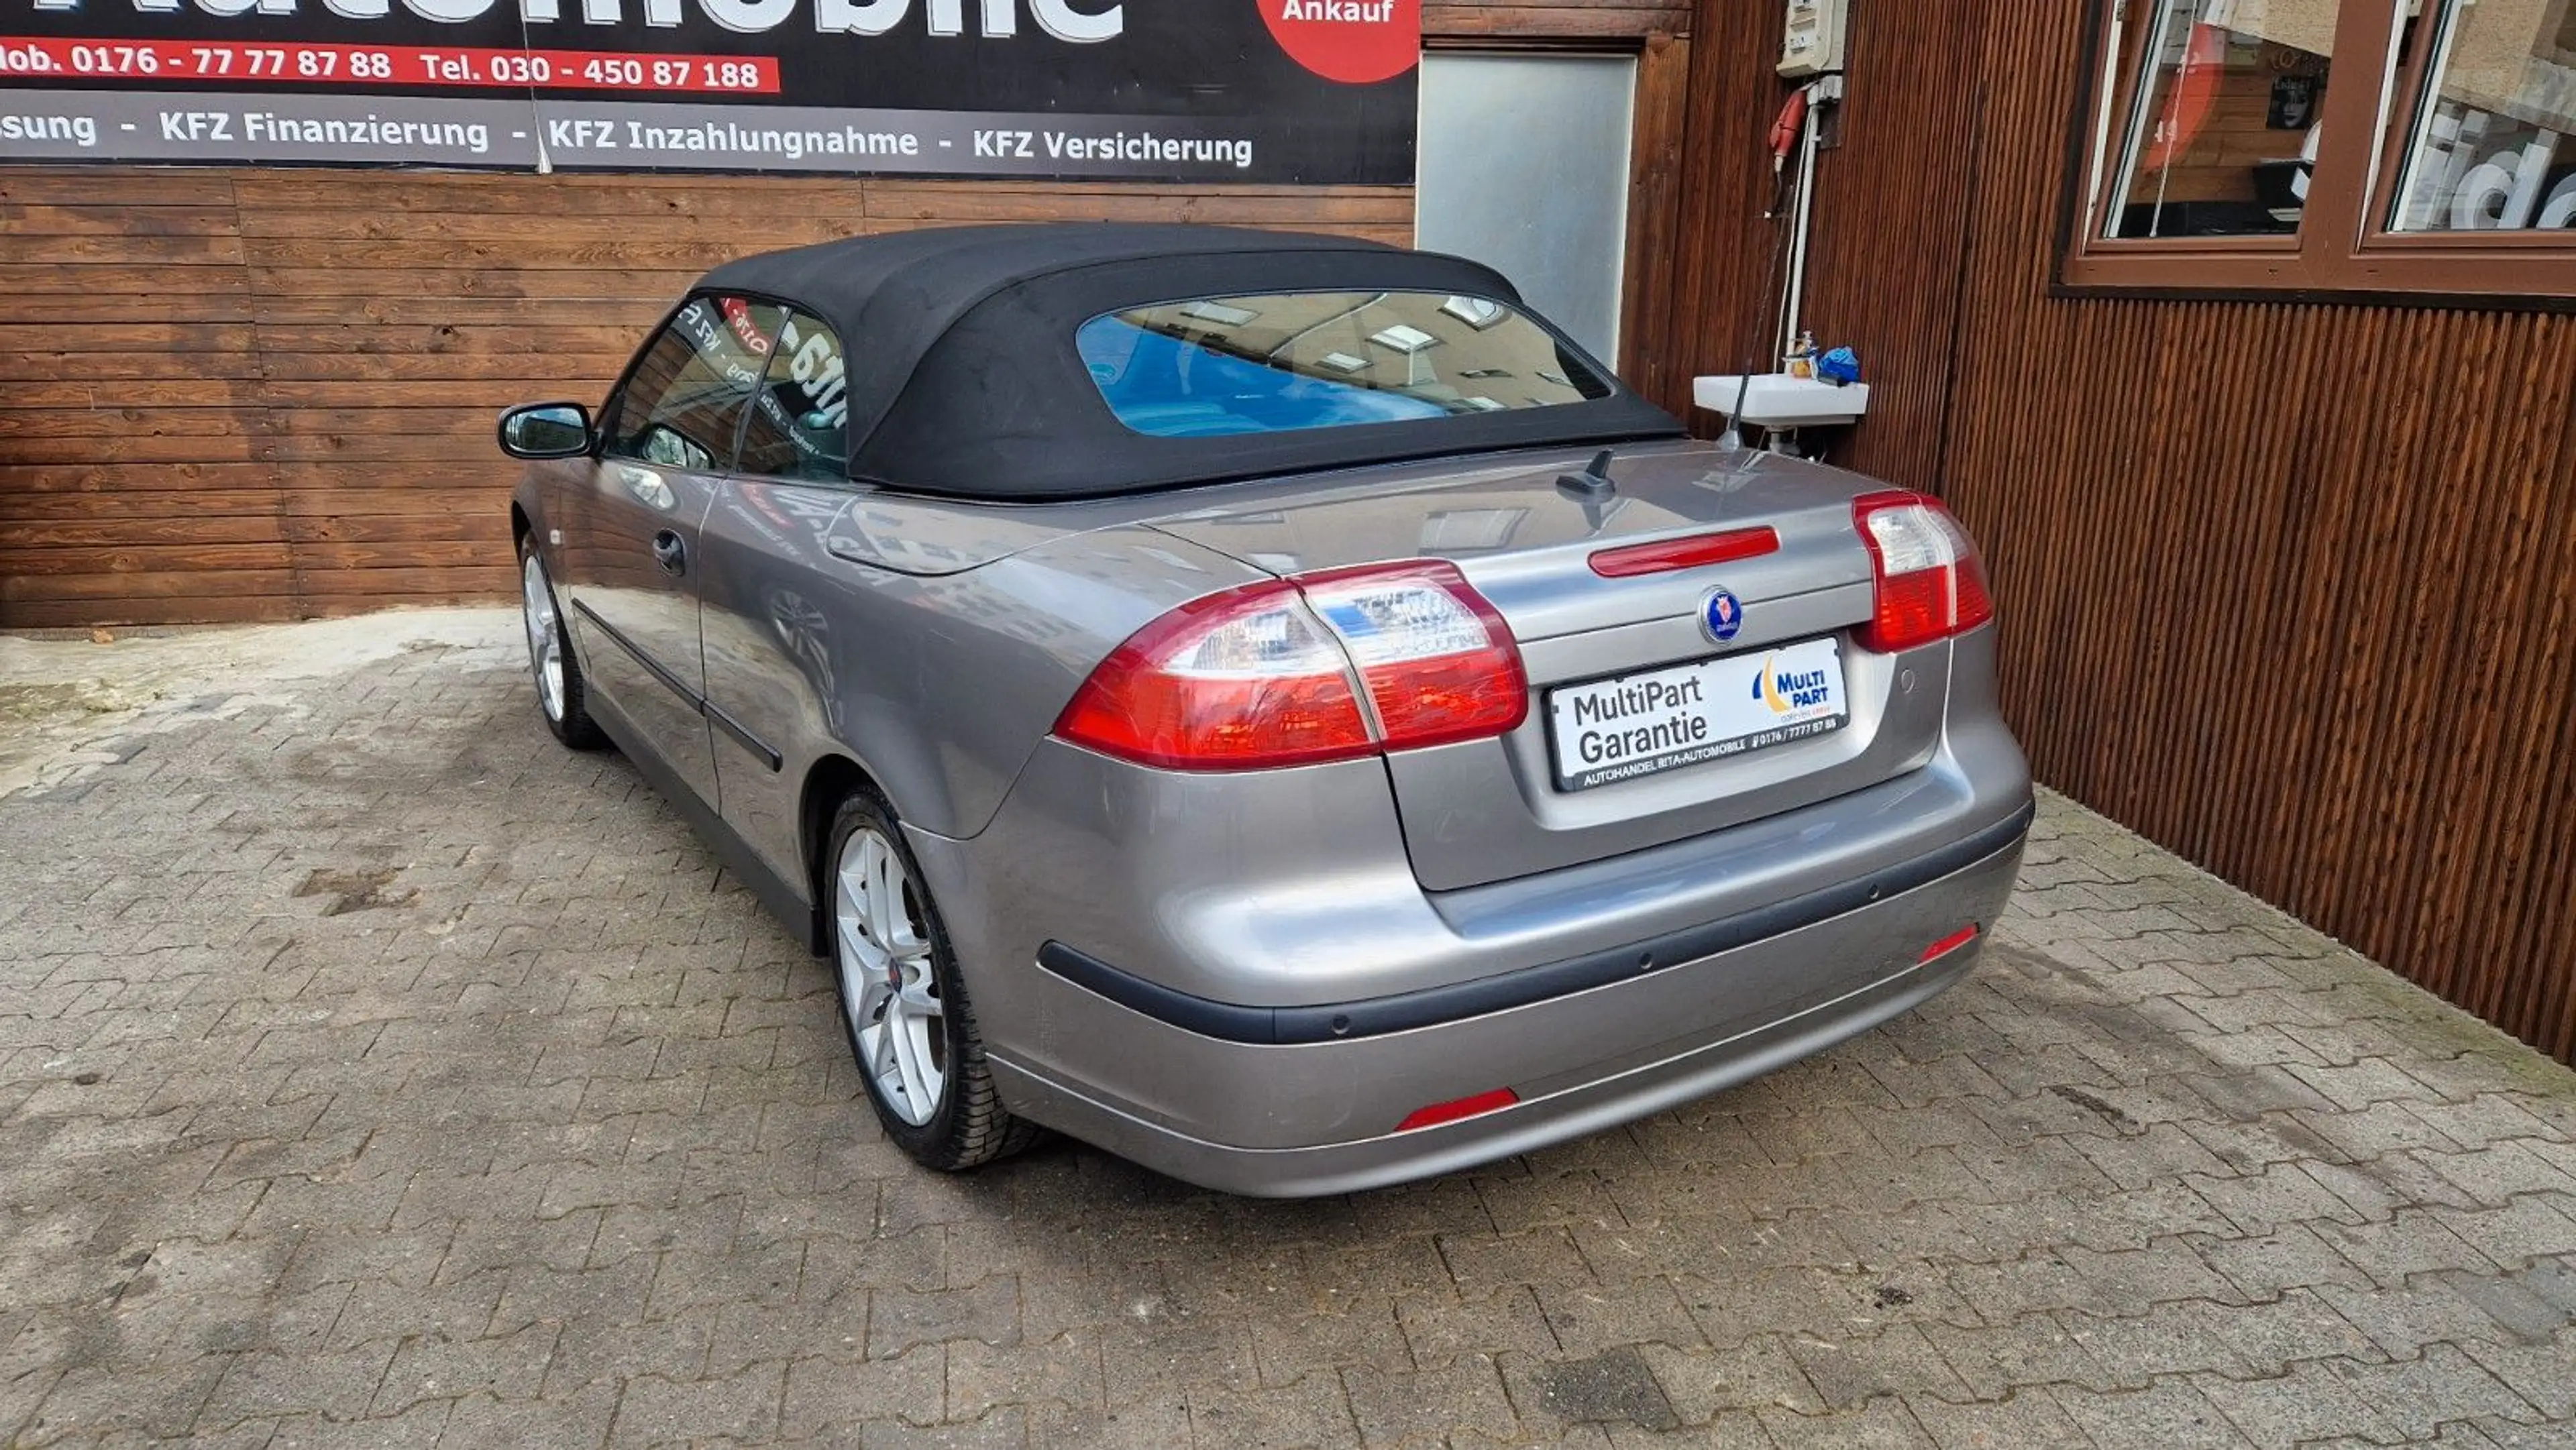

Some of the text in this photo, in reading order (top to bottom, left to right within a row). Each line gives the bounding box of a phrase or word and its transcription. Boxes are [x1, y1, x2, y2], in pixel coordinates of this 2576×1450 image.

[1282, 0, 1394, 22] Ankauf
[72, 47, 158, 74] 0176
[192, 48, 233, 74] 77
[245, 50, 285, 75] 77
[297, 50, 337, 76] 87
[350, 52, 391, 78] 88
[420, 54, 480, 80] Tel.
[491, 56, 550, 82] 030
[584, 60, 643, 85] 450
[653, 61, 690, 87] 87
[703, 62, 759, 89] 188
[0, 115, 97, 147] sung
[159, 112, 233, 141] KFZ
[244, 112, 488, 153] Finanzierung
[549, 119, 617, 148] KFZ
[627, 121, 918, 160] Inzahlungnahme
[974, 130, 1034, 158] KFZ
[1043, 132, 1252, 167] Versicherung
[1777, 669, 1825, 694] MULTI
[1792, 687, 1828, 708] PART
[1574, 676, 1703, 726] MultiPart
[1580, 711, 1707, 763] Garantie
[1584, 759, 1657, 786] AUTOHANDEL
